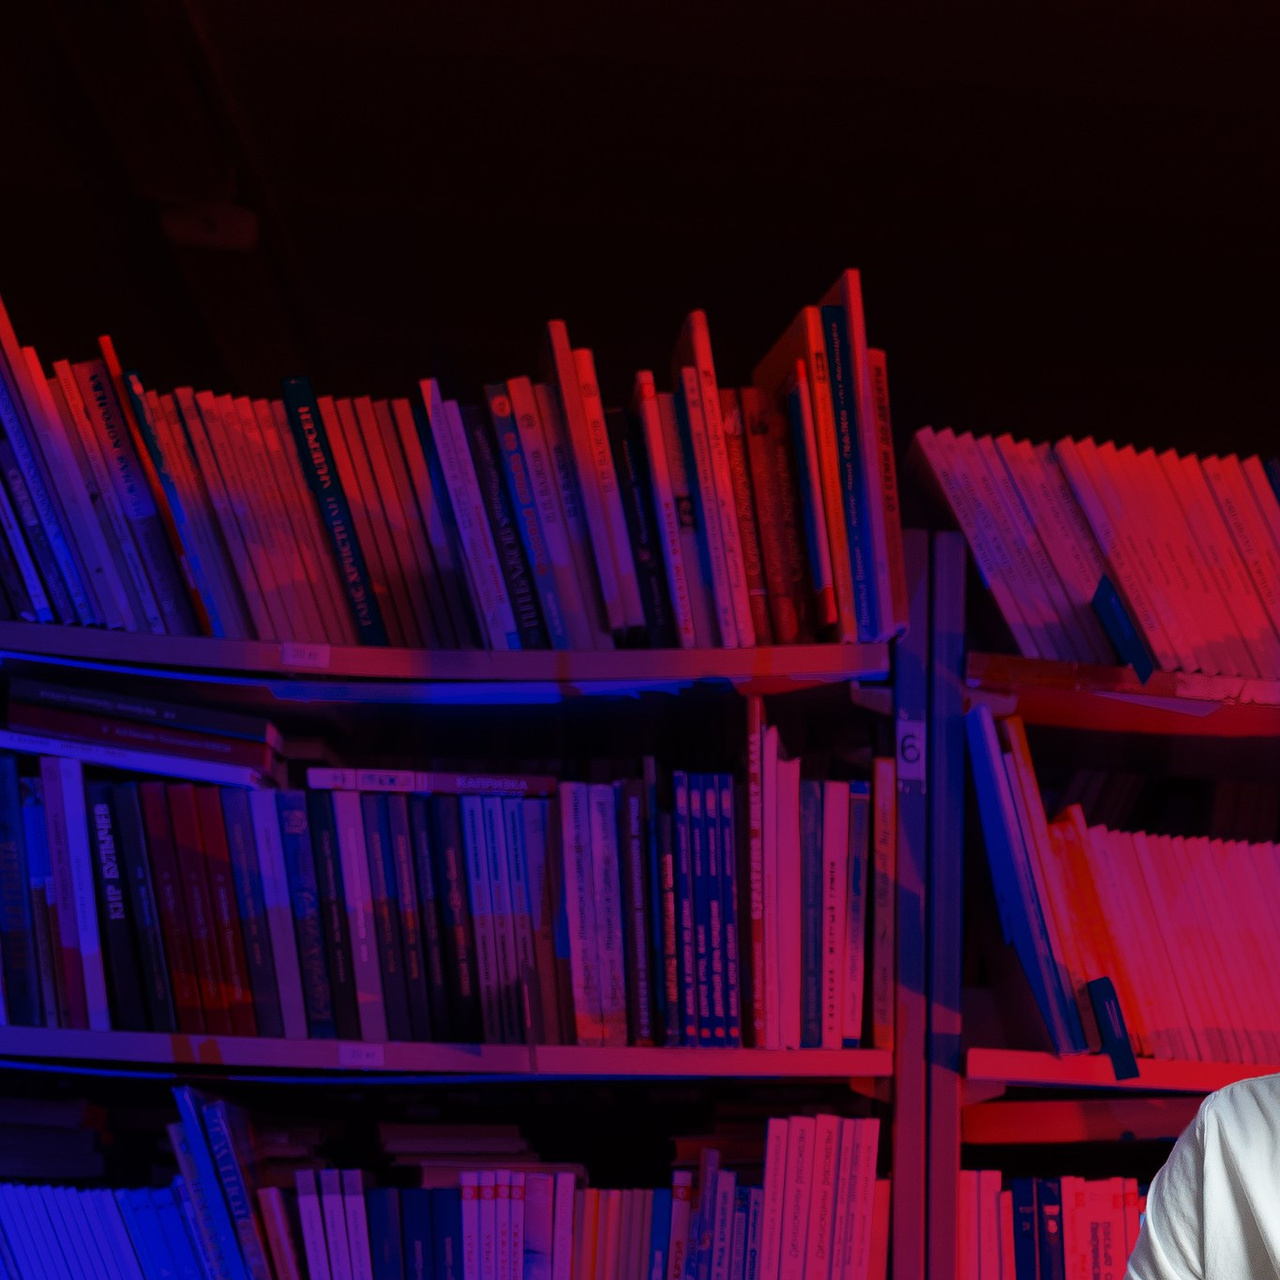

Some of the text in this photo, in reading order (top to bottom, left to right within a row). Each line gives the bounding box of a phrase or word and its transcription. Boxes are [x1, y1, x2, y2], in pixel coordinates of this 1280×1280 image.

[900, 734, 920, 764] 6
[94, 803, 126, 920] КИР БУЛЫЧЕВ
